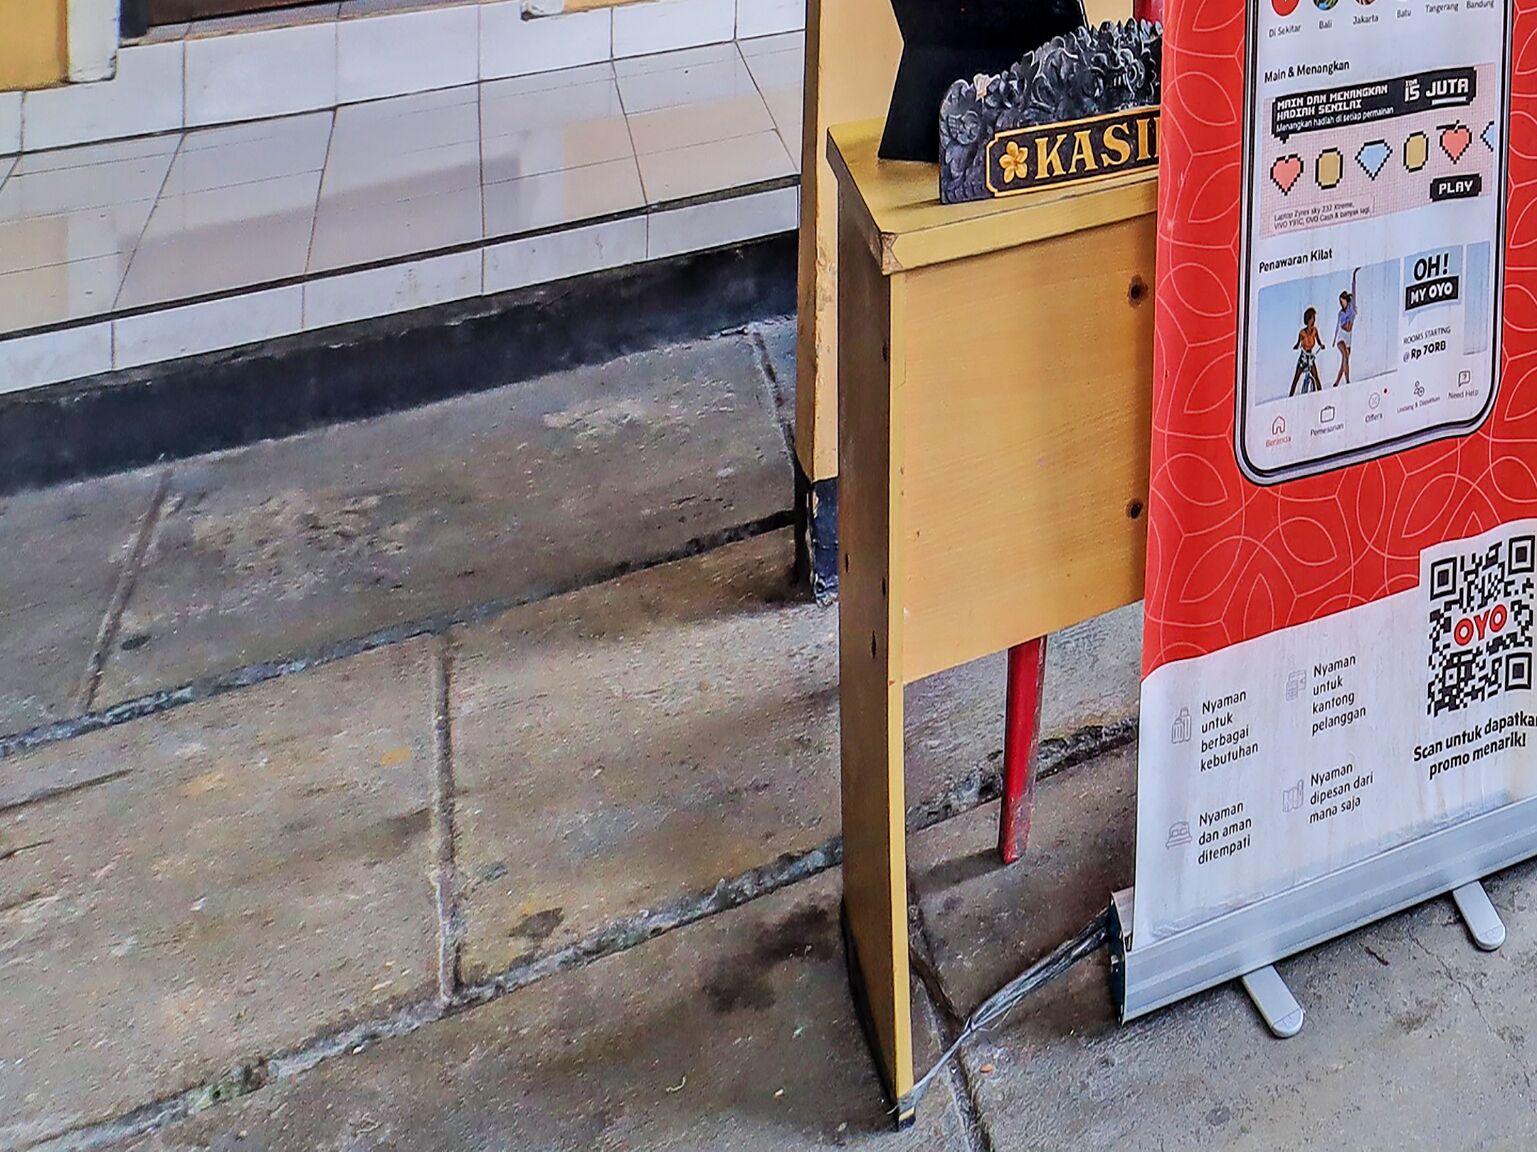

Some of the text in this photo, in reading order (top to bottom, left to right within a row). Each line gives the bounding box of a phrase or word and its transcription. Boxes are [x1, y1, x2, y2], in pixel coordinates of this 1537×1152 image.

[1352, 14, 1379, 25] Jakarta
[1396, 8, 1412, 18] Batu
[1425, 2, 1458, 15] Tangerang
[1268, 24, 1302, 38] Di Sekitar
[1318, 19, 1333, 30] Bali
[1264, 60, 1350, 83] Main & Menangkan
[1277, 84, 1388, 110] MAIN DAN MENANGKAN
[1404, 78, 1469, 102] 15 JUTA
[1276, 100, 1362, 122] HADIAH SENILAI
[1276, 106, 1394, 132] Menangkan hadiah di setiap permainan
[1034, 116, 1161, 181] KASI
[1438, 180, 1474, 196] PLAY
[1274, 212, 1293, 222] Laptop
[1274, 220, 1288, 230] VIVO
[1306, 215, 1318, 224] OVO
[1320, 212, 1334, 221] Cash
[1258, 248, 1333, 274] Penawaran Kilat
[1410, 281, 1453, 304] MY OYO
[1403, 326, 1452, 344] ROOMS STARTING
[1411, 348, 1422, 360] Rp
[1423, 340, 1446, 356] 70RB
[1310, 423, 1344, 436] Pemesanan
[1364, 412, 1382, 424] Offers
[1265, 436, 1292, 448] Beranda
[1454, 603, 1508, 646] OYO
[1313, 655, 1356, 678] Nyaman
[1312, 675, 1344, 696] untuk
[1202, 690, 1247, 716] Nyaman
[1312, 692, 1356, 715] kantong
[1201, 712, 1234, 734] untuk
[1312, 706, 1366, 736] pelanggan
[1200, 725, 1250, 754] berbagai
[1413, 740, 1444, 762] Scan
[1444, 724, 1482, 750] untuk
[1200, 742, 1258, 772] kebutuhan
[1428, 731, 1526, 780] promo menarik!
[1310, 762, 1354, 788] Nyaman
[1309, 770, 1374, 806] dipesan dari
[1199, 802, 1244, 828] Nyaman
[1309, 796, 1362, 824] mana saja
[1198, 818, 1252, 846] dan aman
[1198, 834, 1252, 865] ditempati
